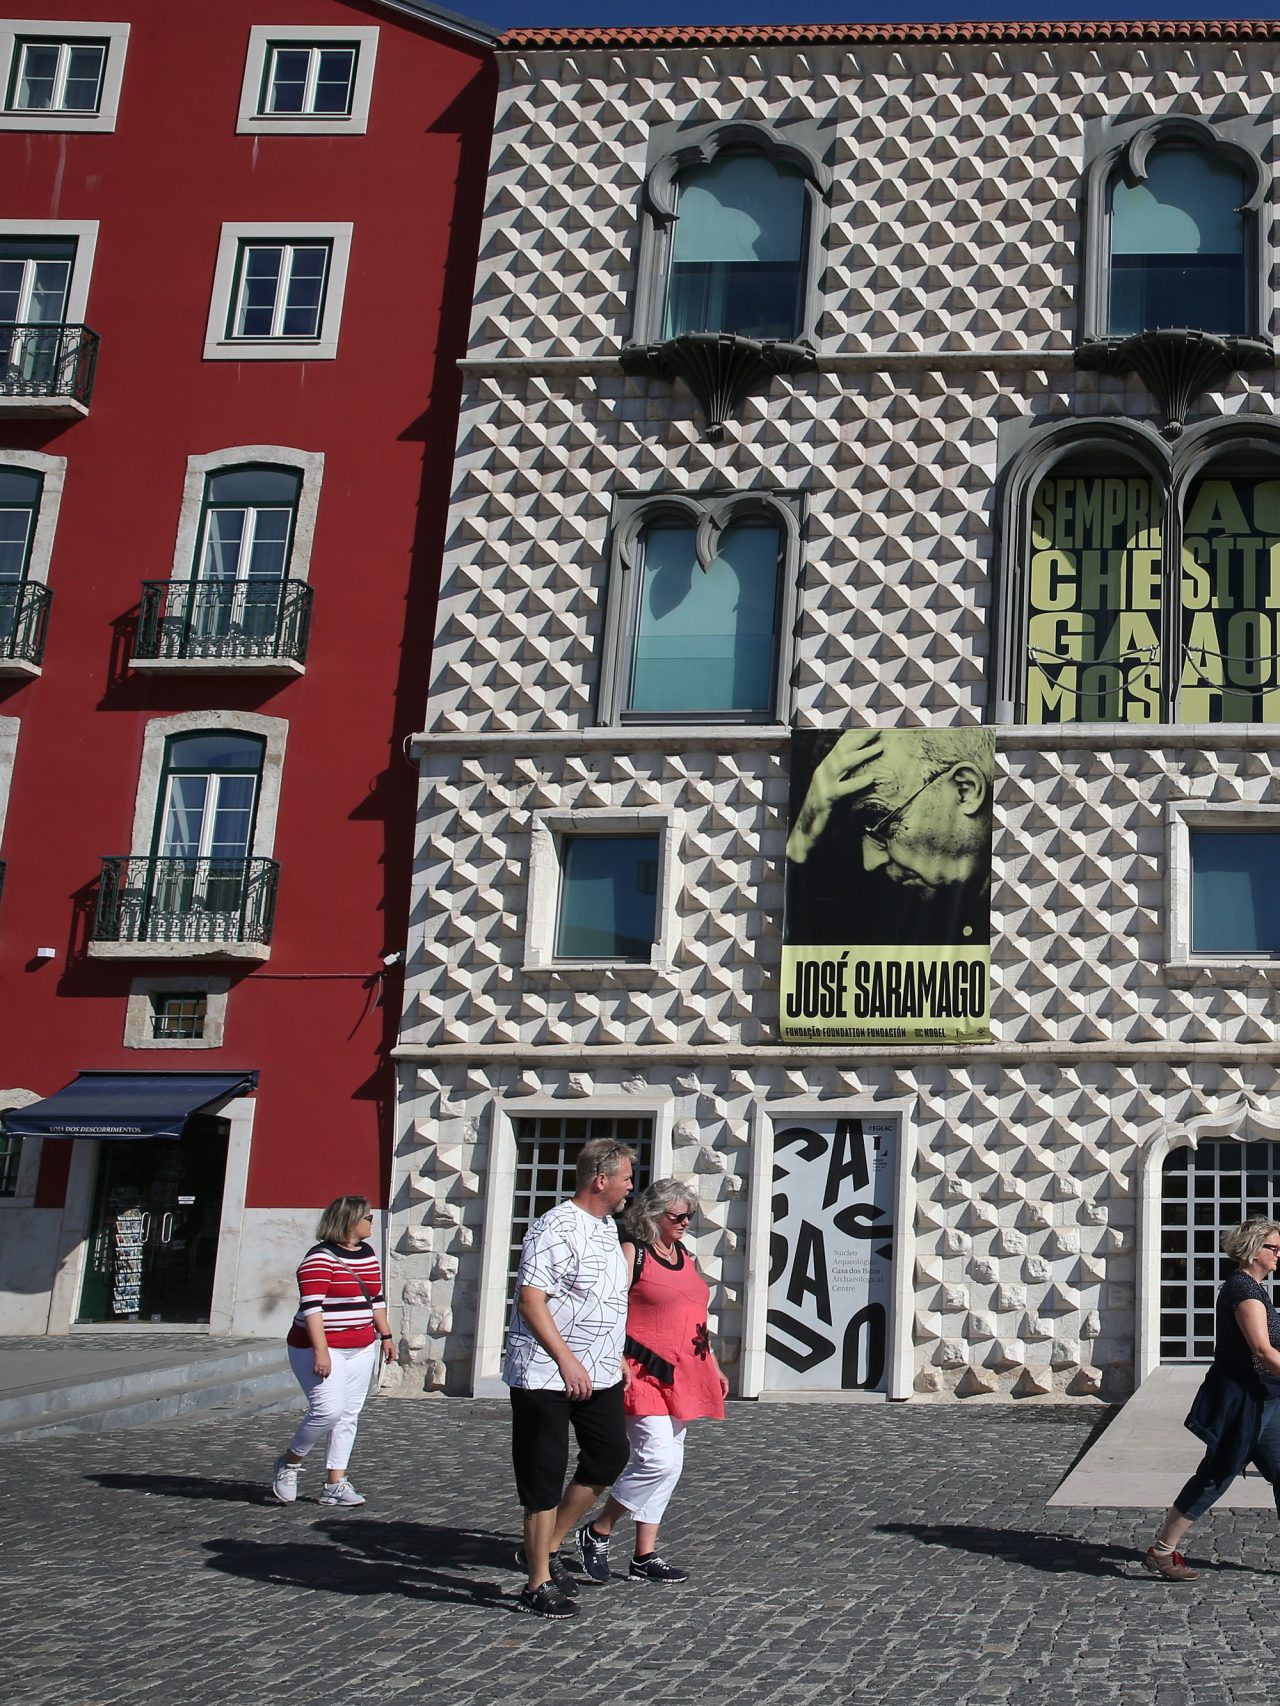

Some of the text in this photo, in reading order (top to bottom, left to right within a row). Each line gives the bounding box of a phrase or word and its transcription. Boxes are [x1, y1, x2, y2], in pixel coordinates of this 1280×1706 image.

[786, 950, 986, 1018] JOSÉ SARAMAGO
[785, 1025, 821, 1039] FUNDAÇÃO
[823, 1028, 865, 1037] FOUNDATION
[867, 1026, 906, 1038] FUNDACIÓN
[924, 1028, 946, 1038] NOBEL
